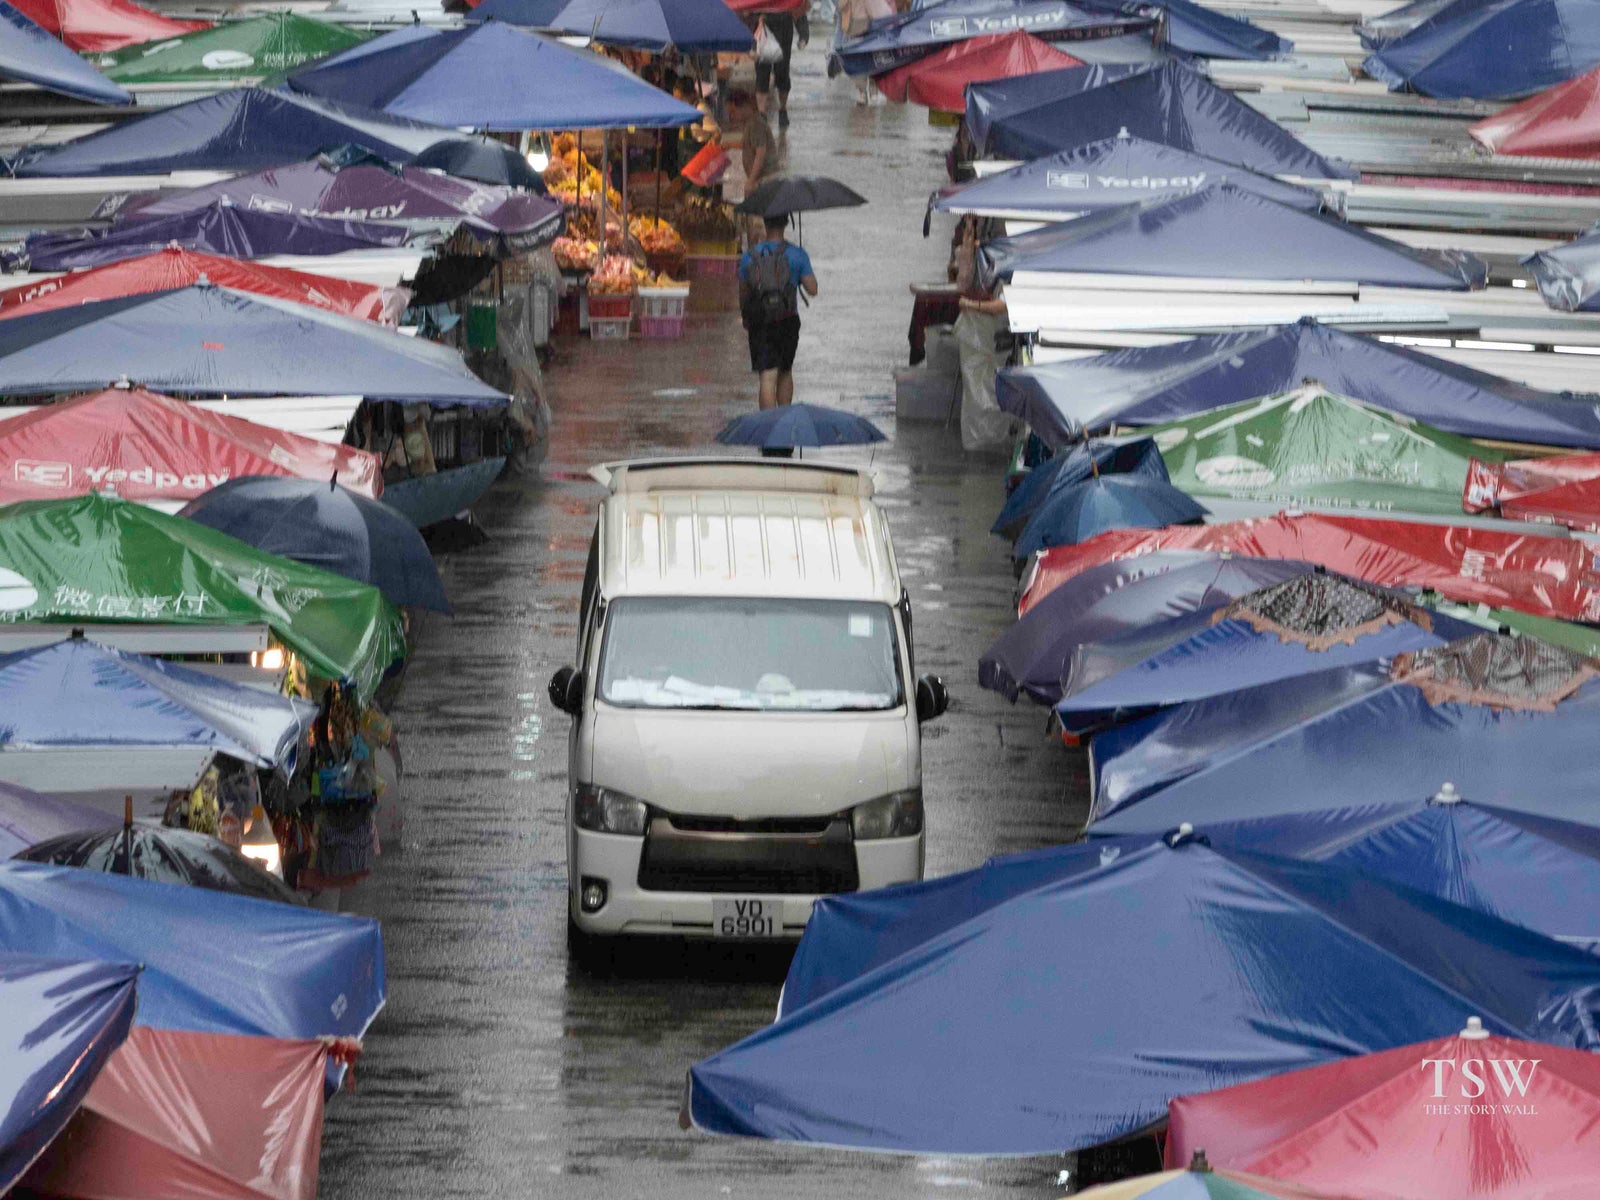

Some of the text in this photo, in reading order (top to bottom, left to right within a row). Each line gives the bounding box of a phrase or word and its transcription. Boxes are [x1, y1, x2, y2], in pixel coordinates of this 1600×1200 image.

[973, 10, 1065, 32] Yedpay
[1097, 172, 1206, 190] Yedpay
[83, 464, 231, 489] Yedpay
[735, 900, 763, 917] VD
[721, 916, 773, 935] 6901
